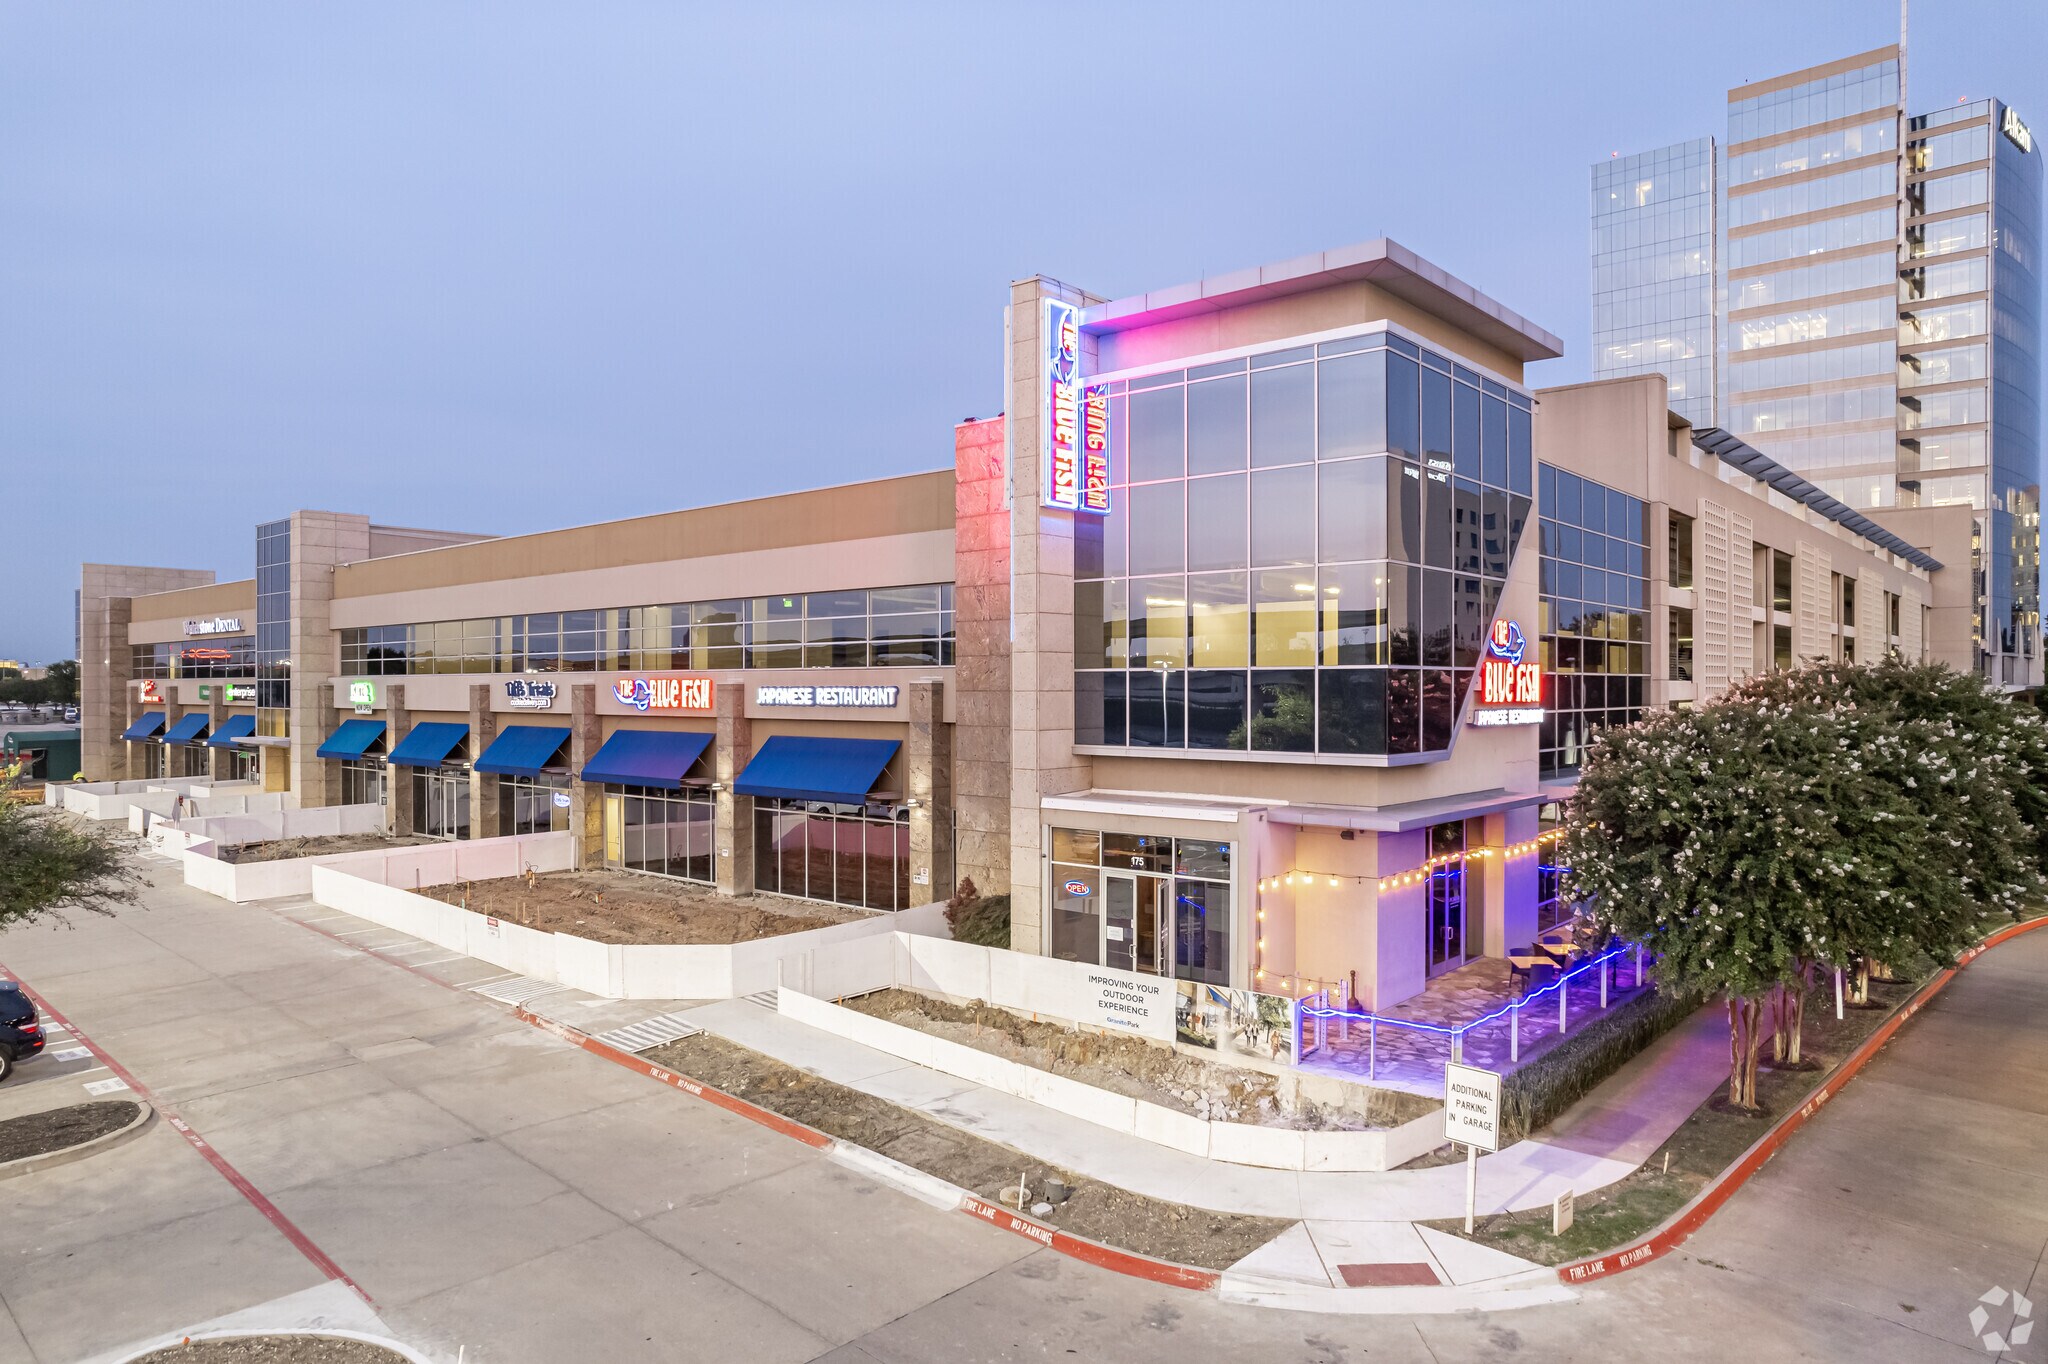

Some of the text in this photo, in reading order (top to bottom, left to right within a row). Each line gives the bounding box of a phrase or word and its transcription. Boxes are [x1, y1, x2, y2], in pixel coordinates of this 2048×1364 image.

[215, 618, 240, 632] DENTAL
[226, 686, 255, 699] enterprise
[757, 687, 898, 706] JAPANESE RESTAURANT
[1131, 856, 1144, 866] 175
[1068, 884, 1088, 893] OPEN
[1088, 975, 1160, 995] IMPROVING YOUR
[1103, 989, 1144, 1004] OUTDOOR
[1098, 1000, 1149, 1017] EXPERIENCE
[683, 1081, 703, 1095] PARKING
[1451, 1083, 1493, 1101] ADDITIONAL
[1456, 1099, 1487, 1115] PARKING
[1449, 1113, 1493, 1132] IN GARAGE
[978, 1203, 996, 1220] LANE
[1010, 1217, 1053, 1244] NO PARKING
[1618, 1244, 1653, 1268] NO PARKING
[1569, 1260, 1606, 1281] FIRE LANE
